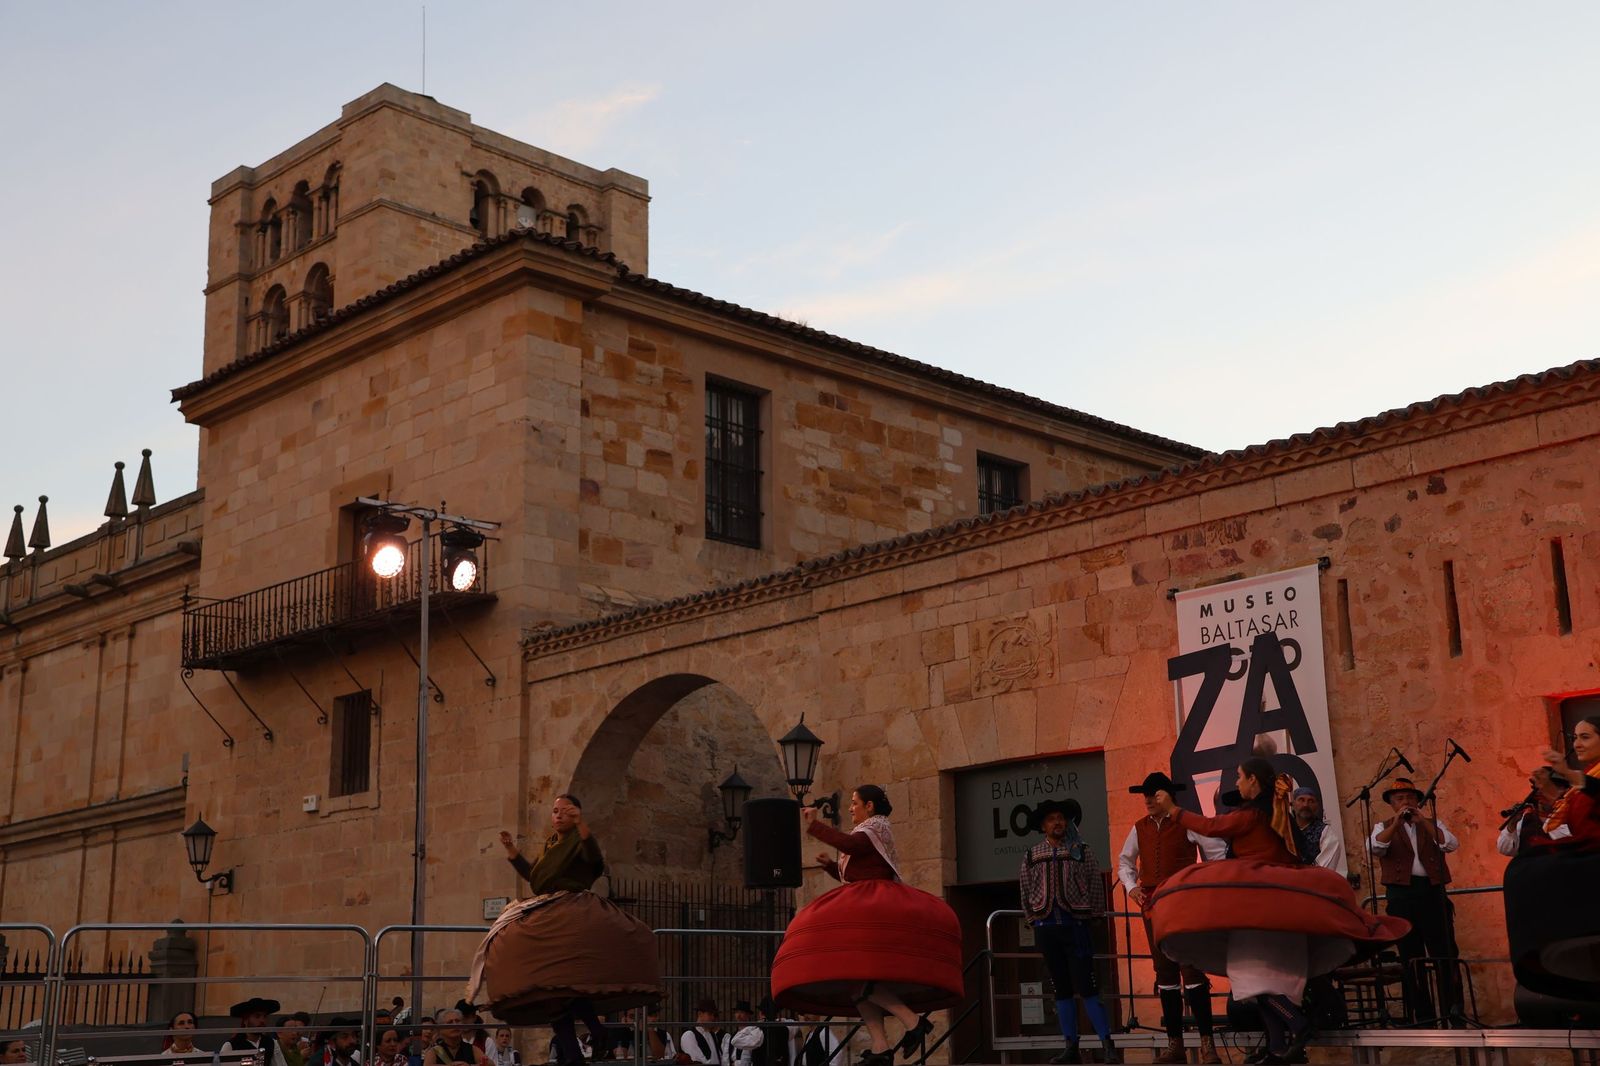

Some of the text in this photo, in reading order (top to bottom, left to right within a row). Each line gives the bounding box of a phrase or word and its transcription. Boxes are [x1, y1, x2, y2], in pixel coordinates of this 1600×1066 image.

[1200, 586, 1297, 618] MUSEO
[1200, 609, 1300, 645] BALTASAR
[991, 772, 1079, 800] BALTASAR
